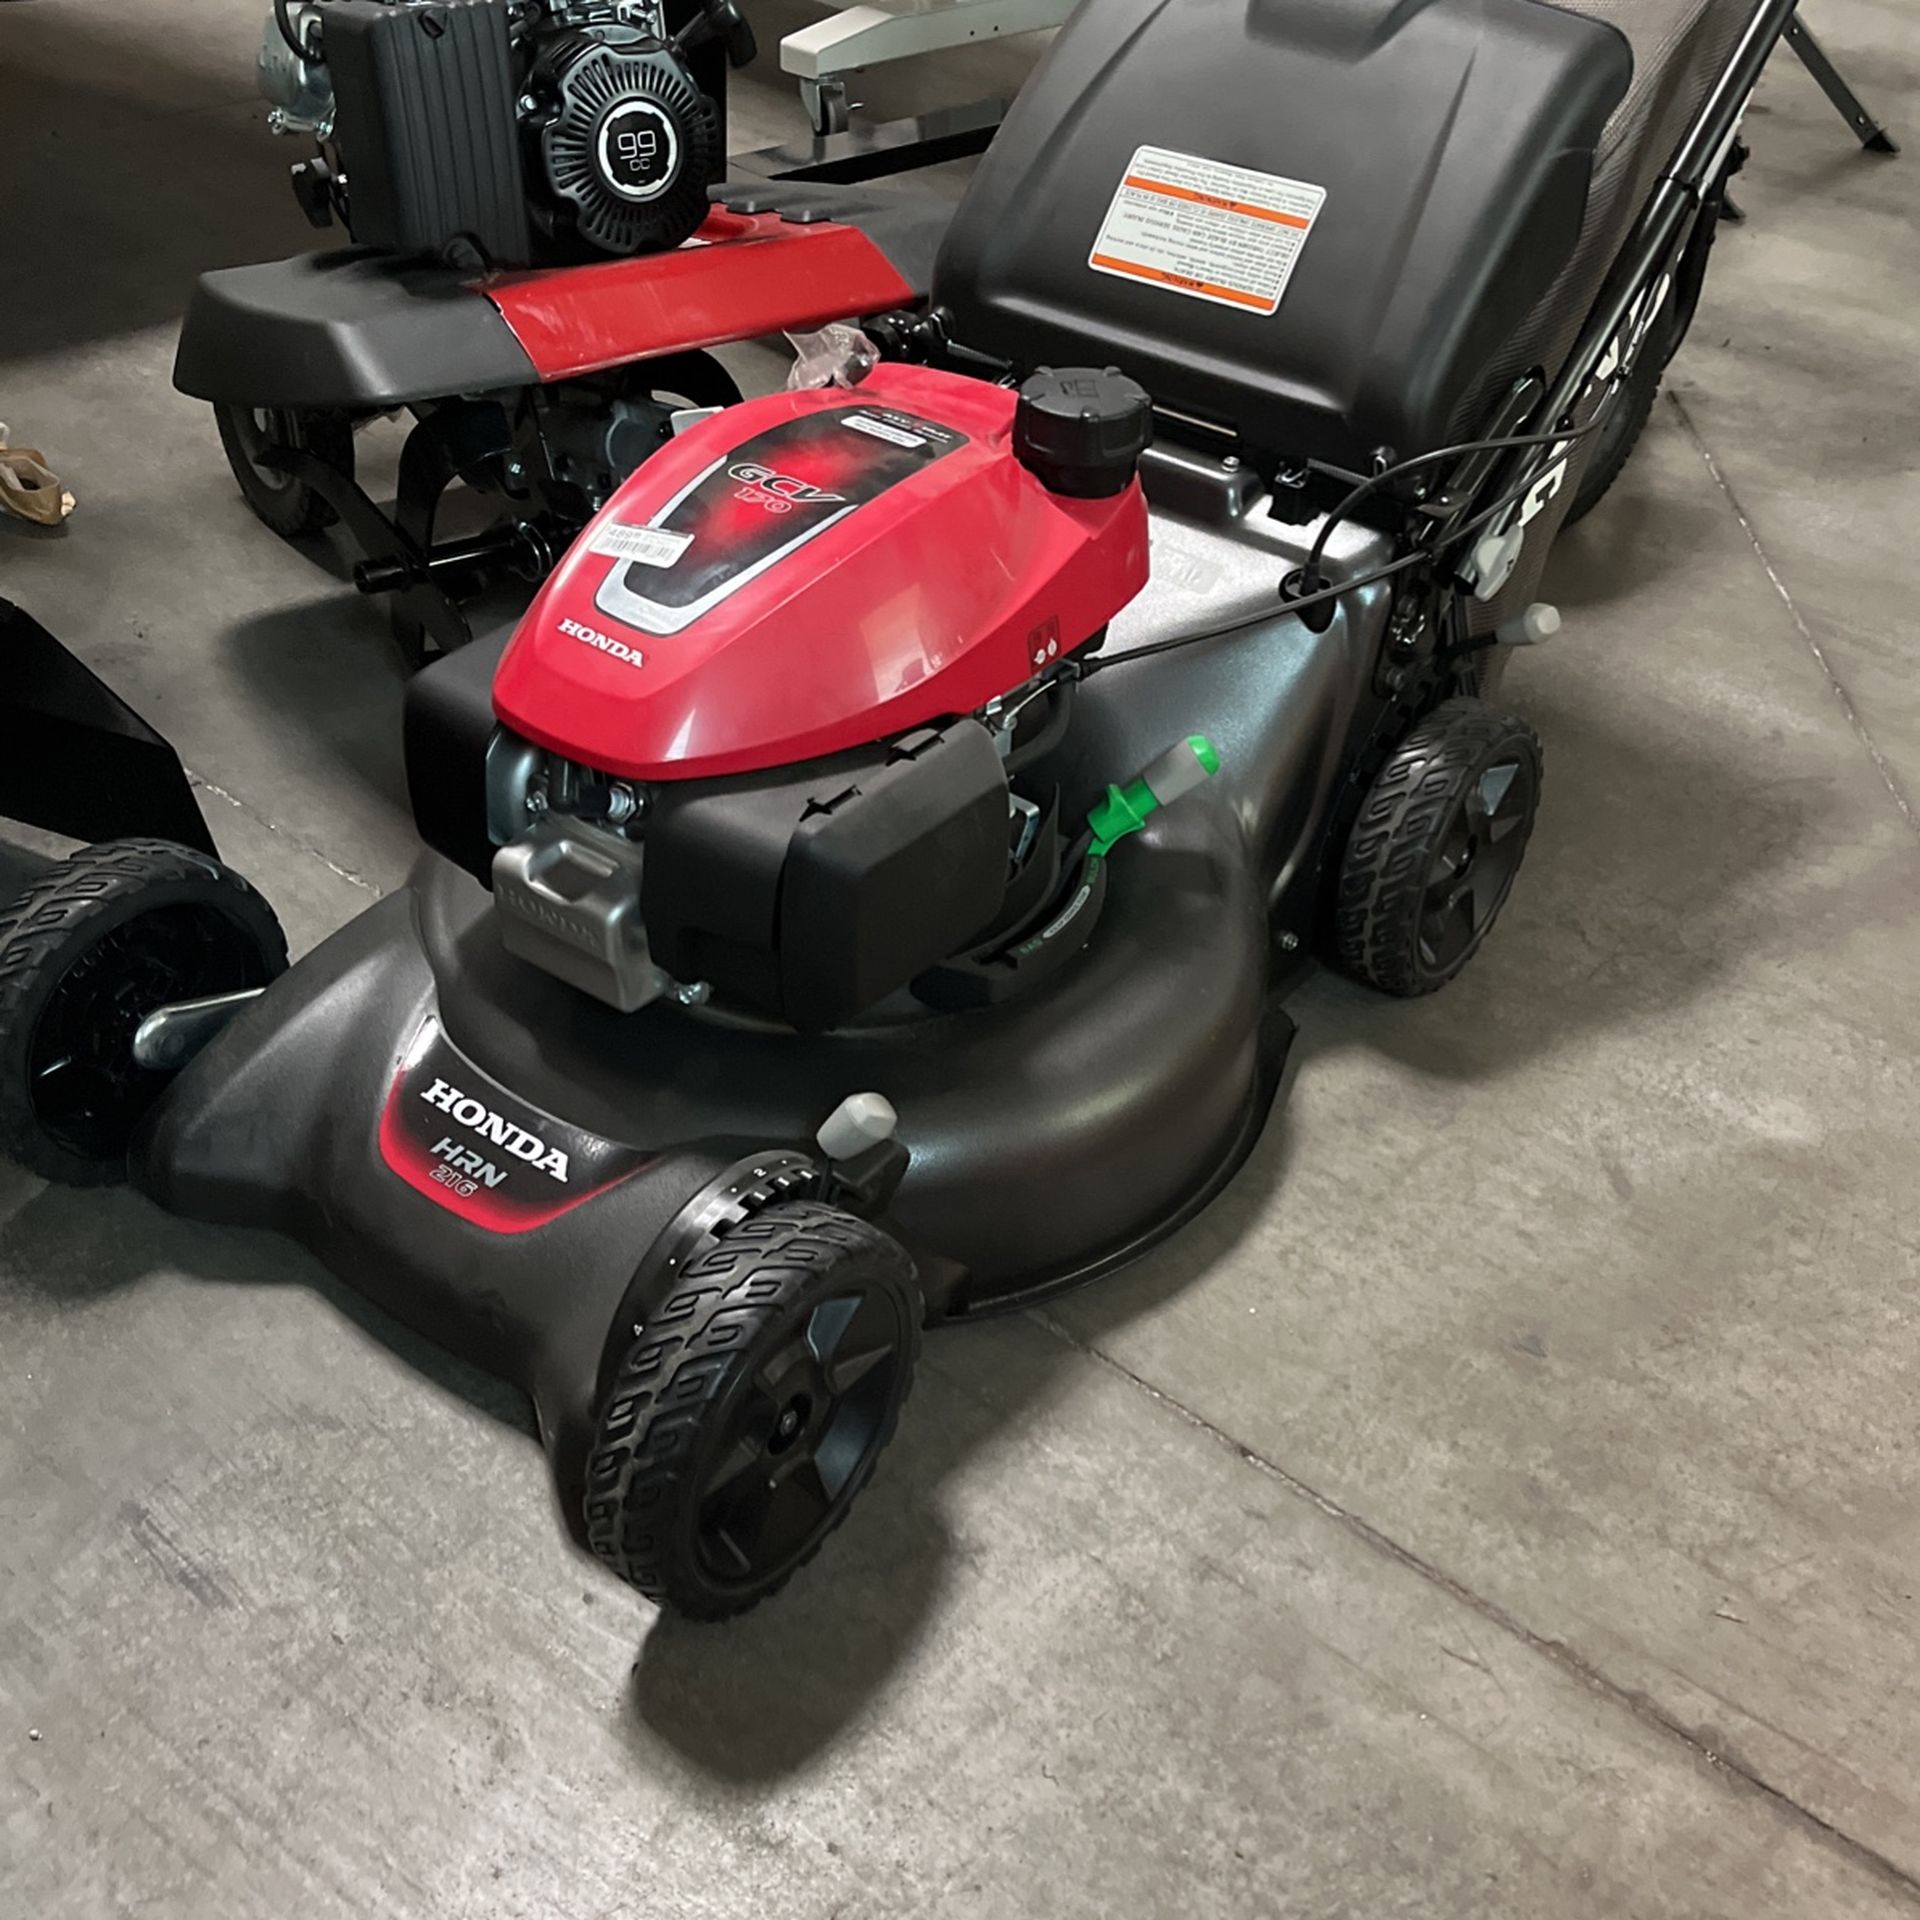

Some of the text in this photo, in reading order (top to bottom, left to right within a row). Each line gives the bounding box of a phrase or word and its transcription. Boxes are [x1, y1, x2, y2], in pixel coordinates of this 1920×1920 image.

[617, 130, 656, 160] 99
[728, 463, 846, 502] GCV
[734, 487, 792, 514] 170
[557, 618, 643, 668] HONDA
[420, 1078, 569, 1183] HONDA
[429, 1163, 479, 1198] 216
[430, 1137, 508, 1188] HRN
